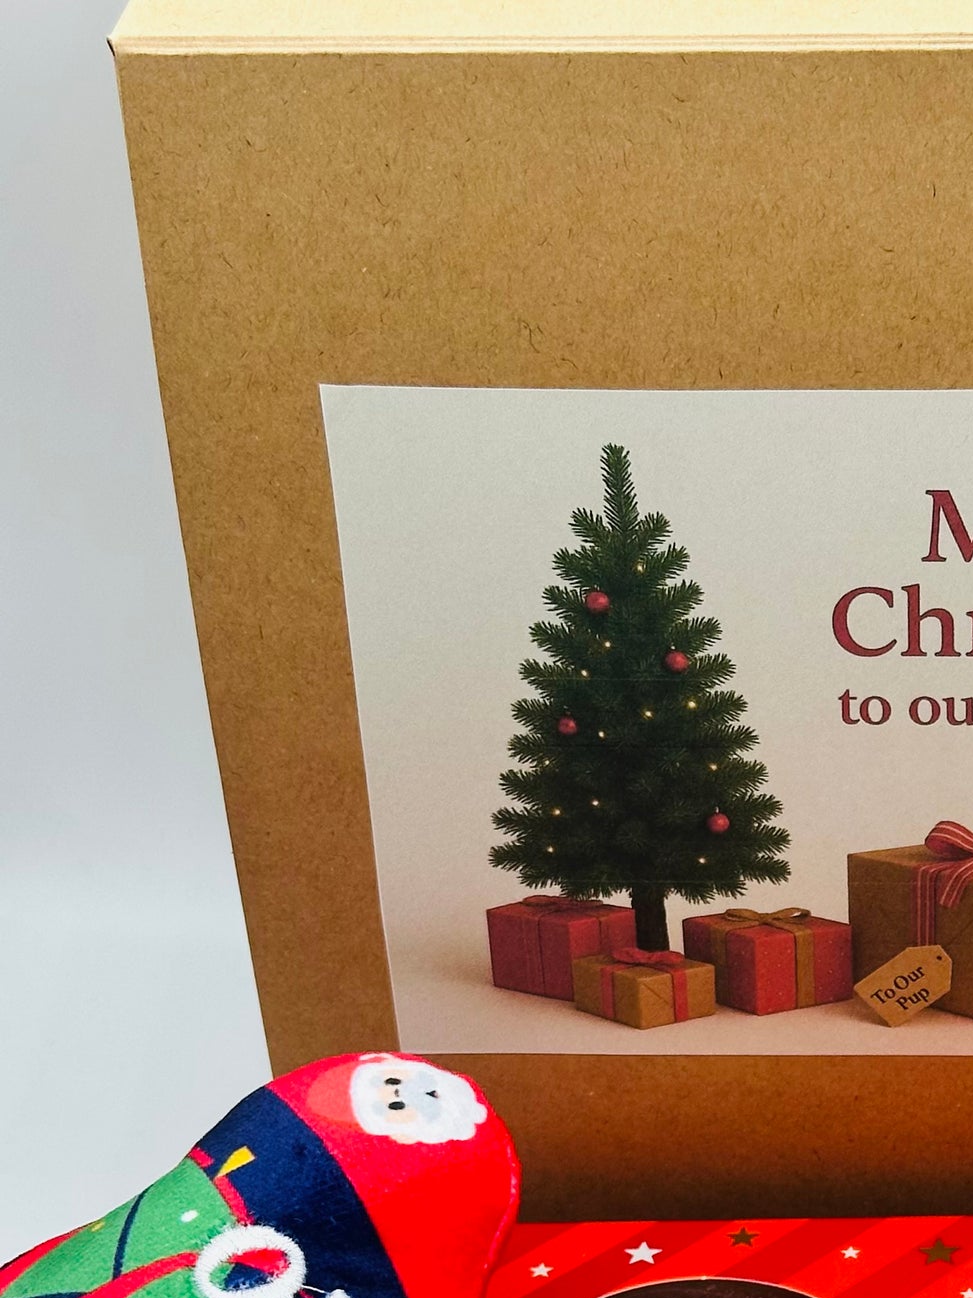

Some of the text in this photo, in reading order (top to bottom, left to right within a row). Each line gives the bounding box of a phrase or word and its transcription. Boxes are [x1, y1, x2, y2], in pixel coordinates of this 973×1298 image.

[838, 688, 893, 726] to
[870, 967, 925, 1004] To Our
[896, 988, 929, 1010] Pup
